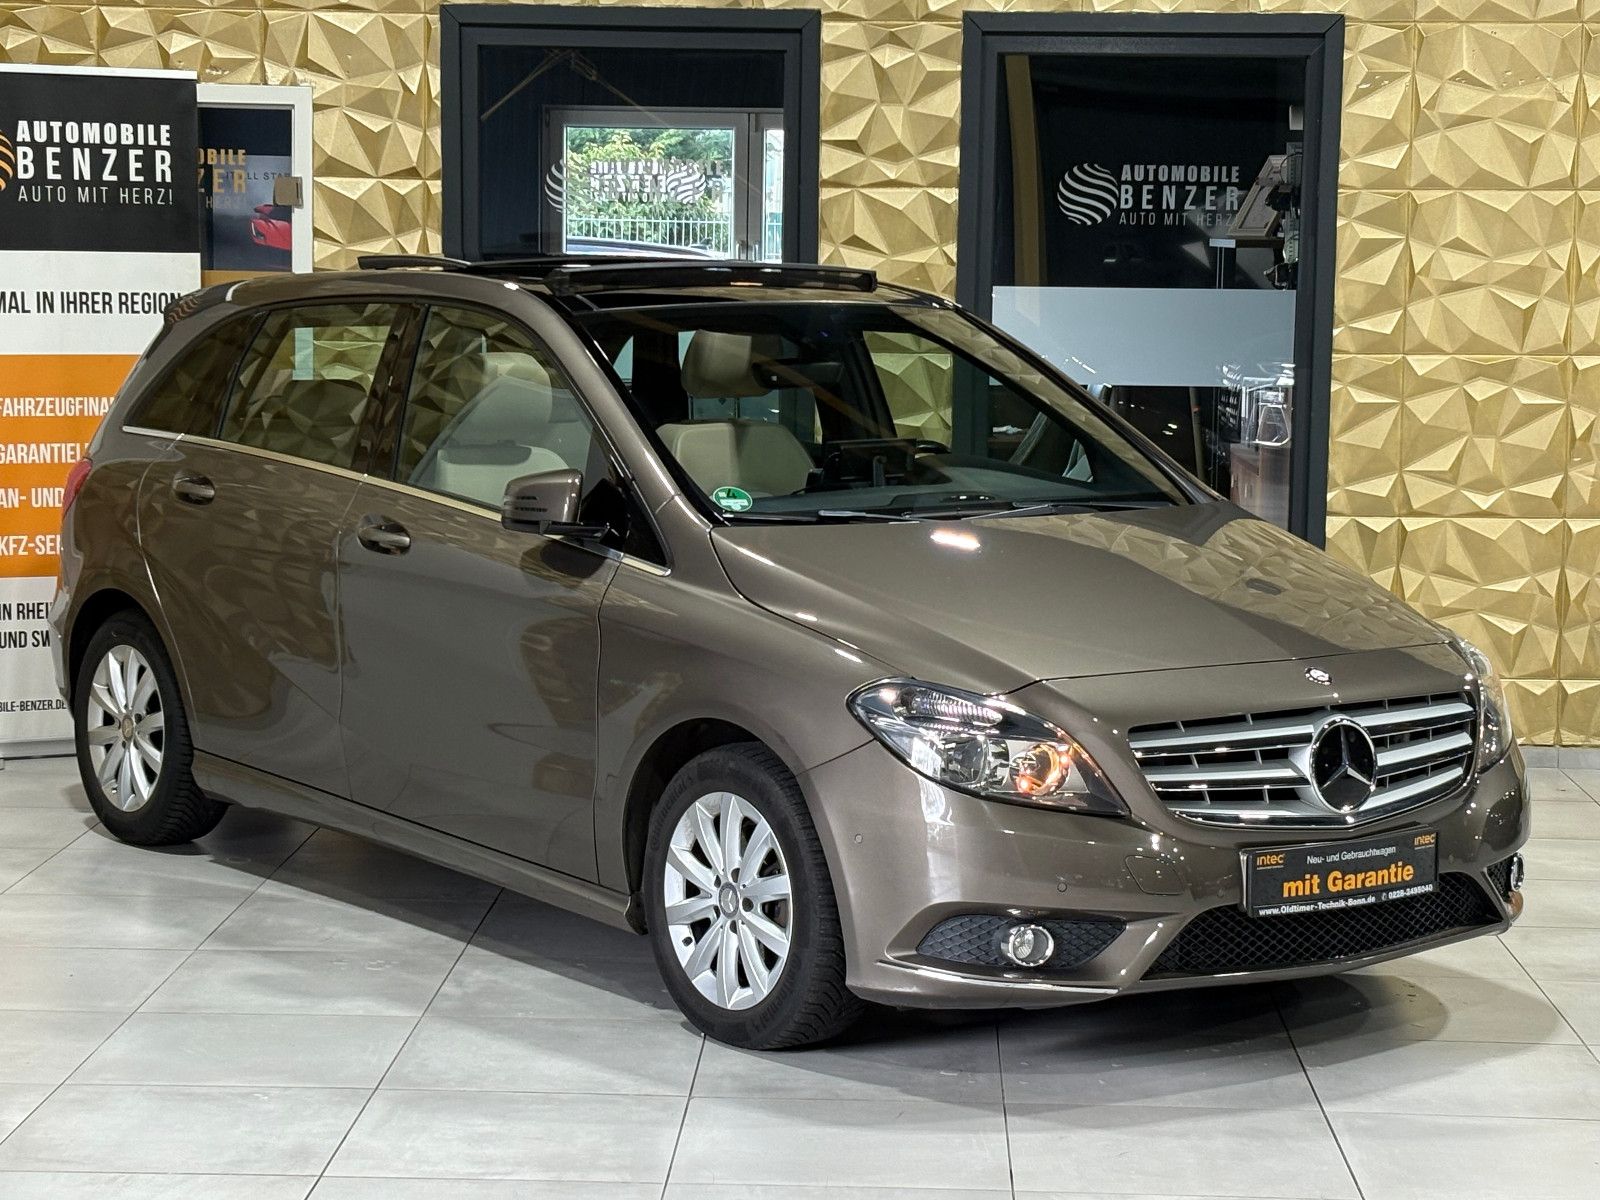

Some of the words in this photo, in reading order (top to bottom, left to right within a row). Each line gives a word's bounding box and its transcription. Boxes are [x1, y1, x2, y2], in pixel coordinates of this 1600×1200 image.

[16, 120, 171, 146] AUTOMOBILE
[16, 146, 172, 182] BENZER
[1121, 164, 1240, 183] AUTOMOBILE
[18, 185, 66, 202] AUTO
[78, 186, 109, 204] MIT
[119, 187, 173, 205] HERZ!
[1120, 185, 1239, 211] BENZER
[1119, 212, 1156, 226] AUTO
[1164, 212, 1188, 226] MIT
[36, 291, 54, 314] IN
[60, 291, 113, 314] IHRER
[31, 487, 65, 508] UND
[0, 630, 28, 649] UND
[1414, 833, 1435, 846] intec
[1257, 853, 1285, 866] intec
[1306, 854, 1325, 865] Neu-
[1325, 852, 1340, 863] und
[1340, 846, 1397, 862] Gebrauchtwagen
[1282, 873, 1321, 898] mit
[1327, 861, 1415, 893] Garantie
